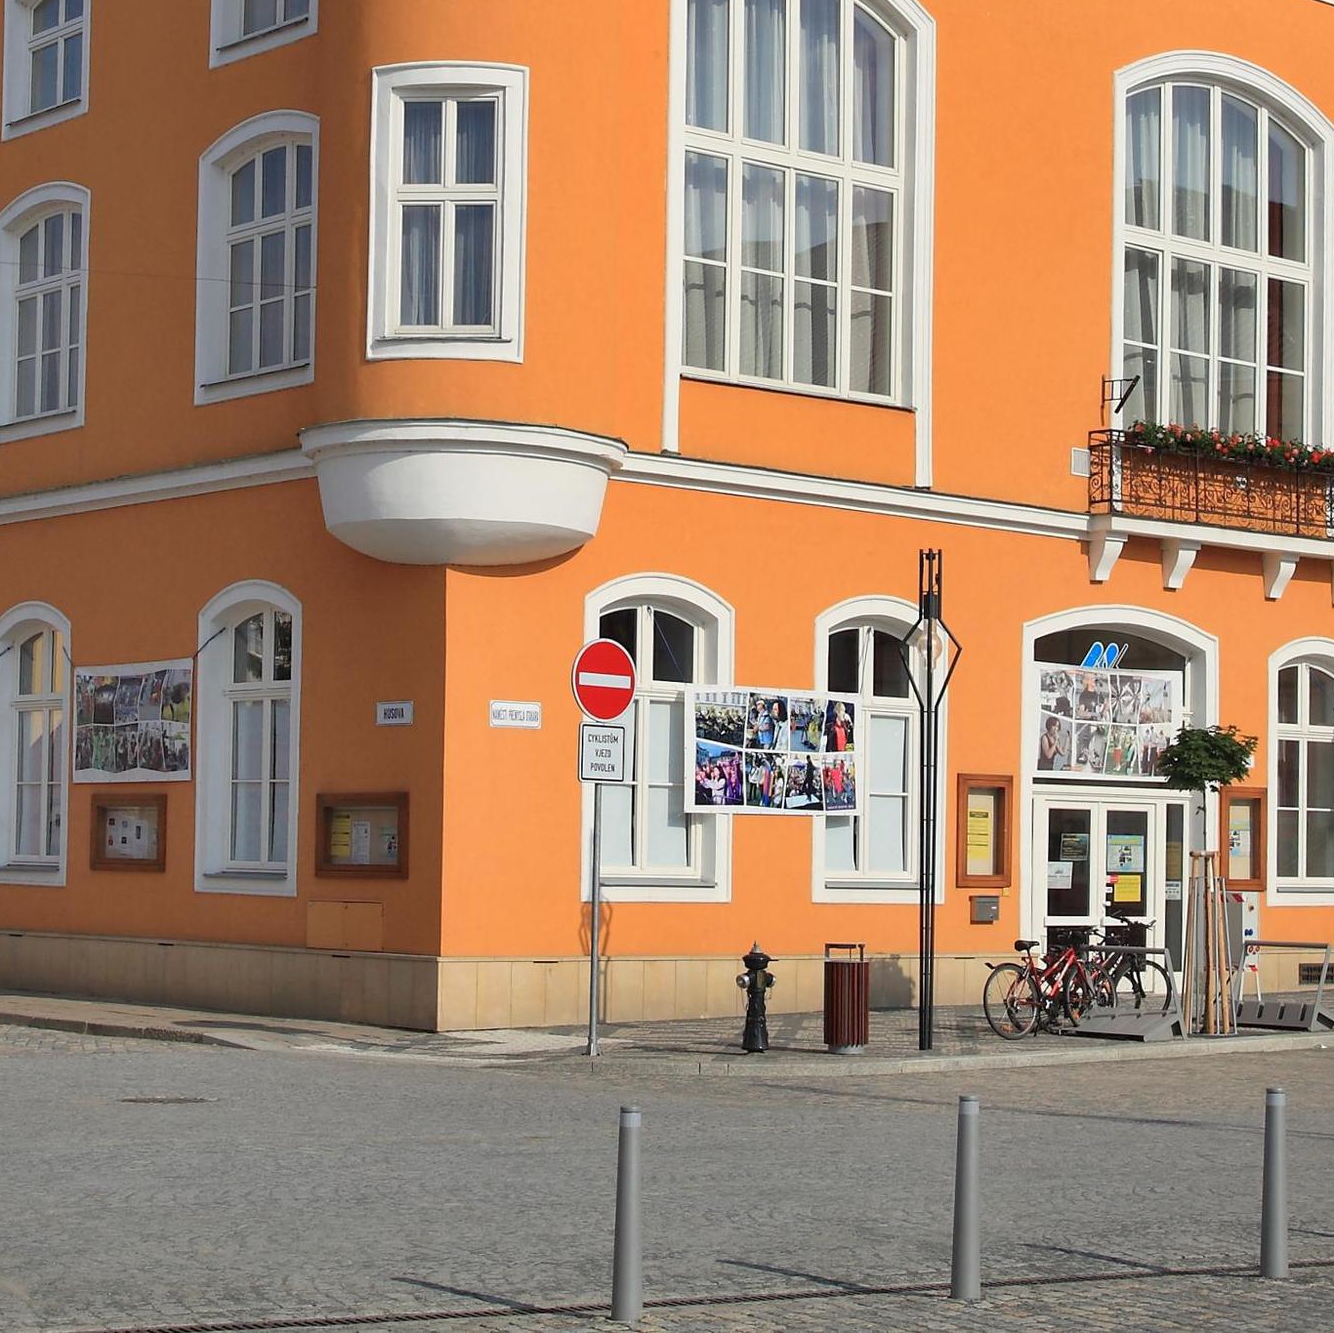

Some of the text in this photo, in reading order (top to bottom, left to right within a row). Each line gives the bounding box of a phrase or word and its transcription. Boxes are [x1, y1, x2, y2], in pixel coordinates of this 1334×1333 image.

[588, 732, 619, 744] CYKLISTŮM
[595, 748, 612, 758] VJEZD
[590, 762, 615, 773] POVOLEN
